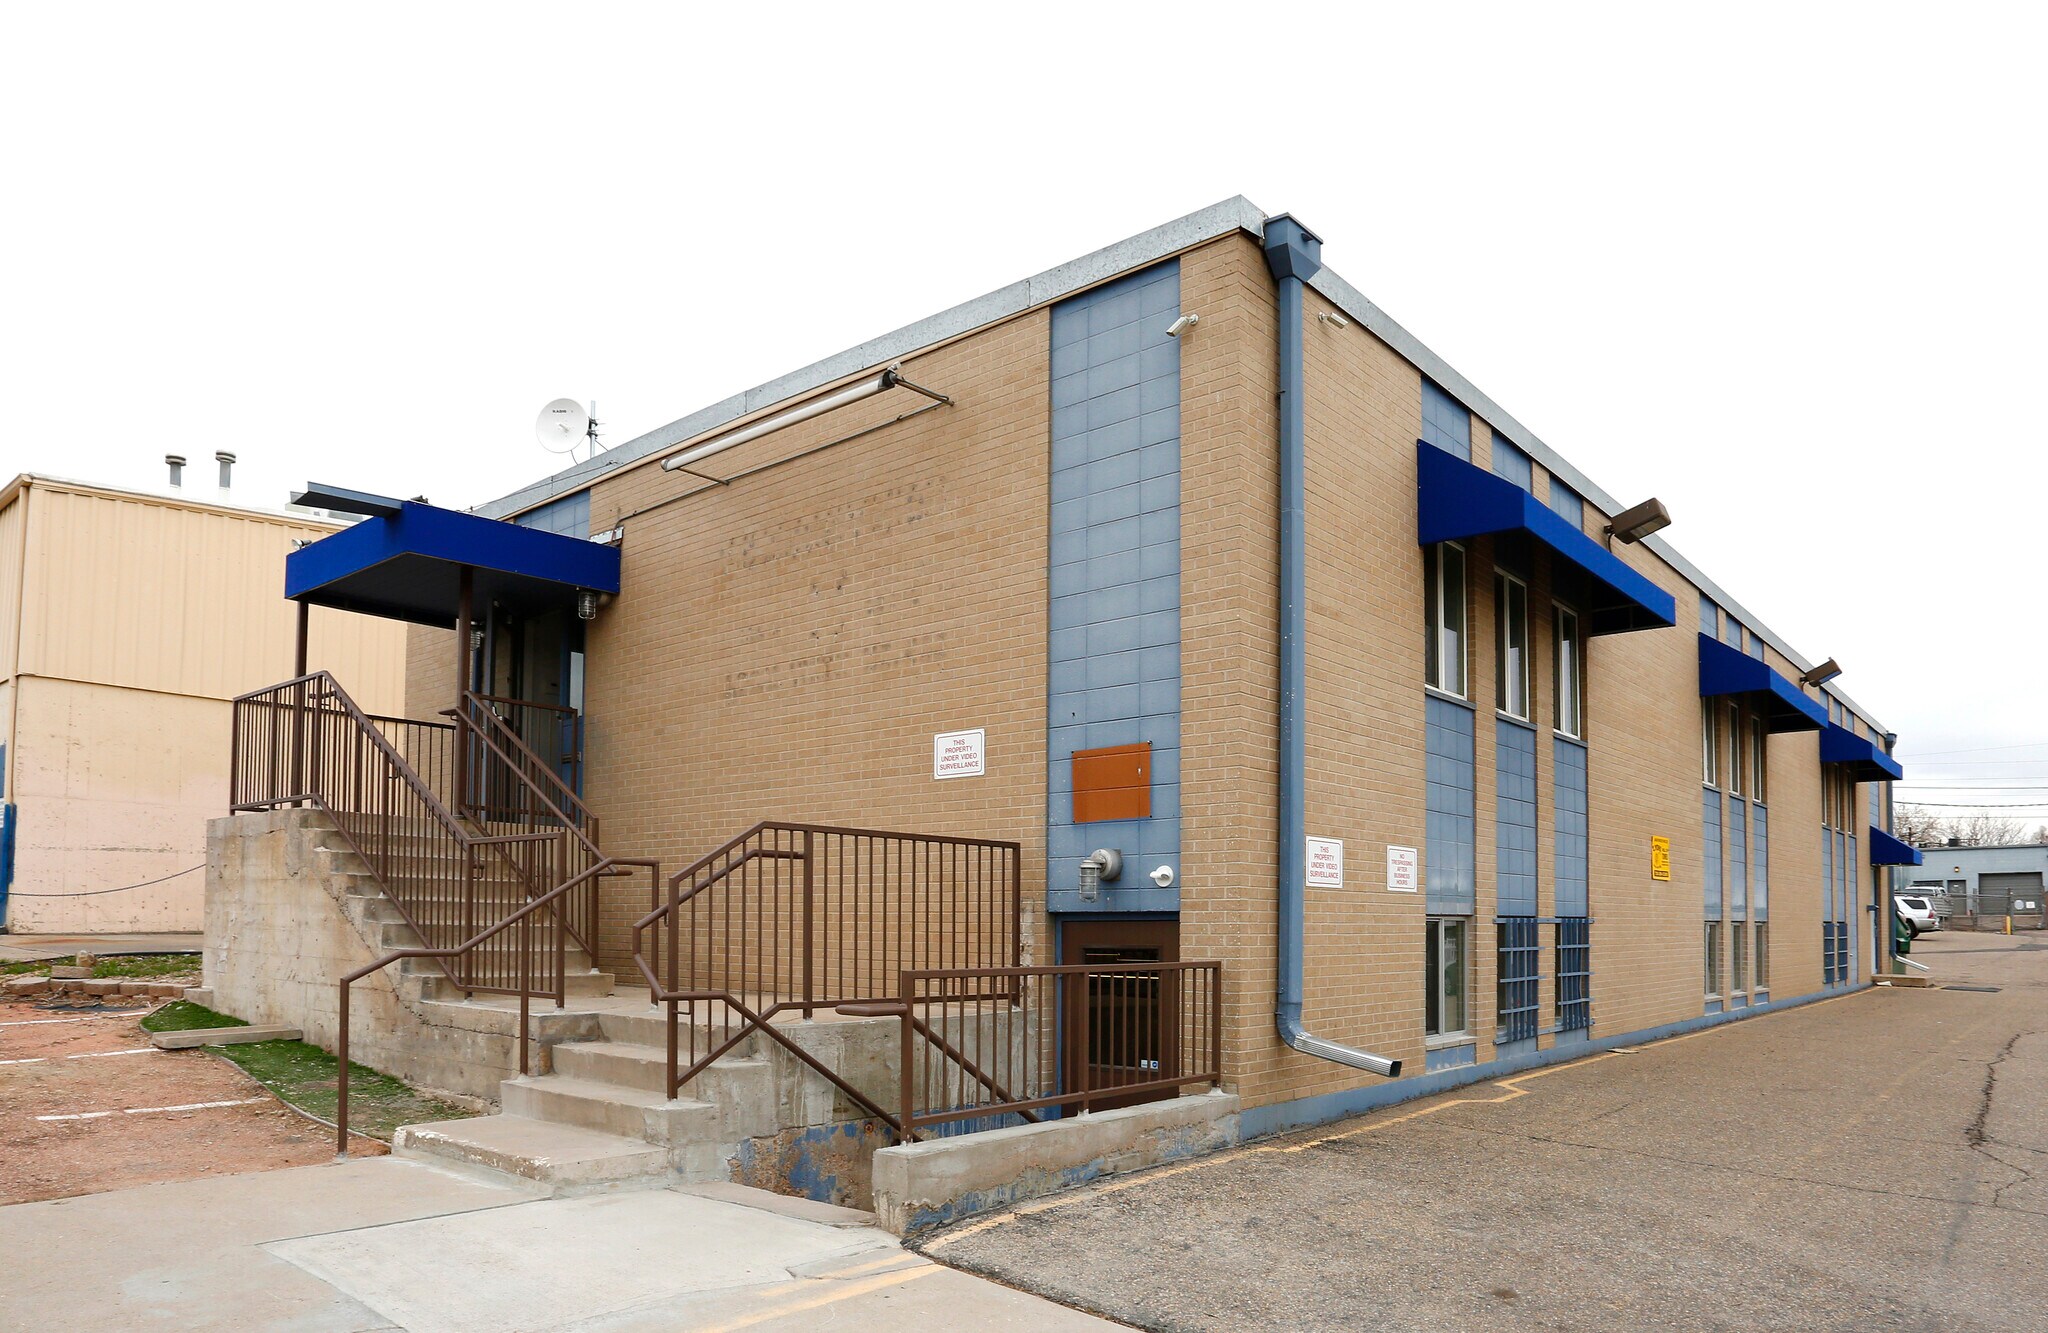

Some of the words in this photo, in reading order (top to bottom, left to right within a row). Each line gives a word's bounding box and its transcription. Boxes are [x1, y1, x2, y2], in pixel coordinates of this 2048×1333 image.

[945, 745, 973, 753] PROPERTY
[939, 761, 979, 770] SURVEILLANCE
[1310, 870, 1339, 879] SURVEILLANCE
